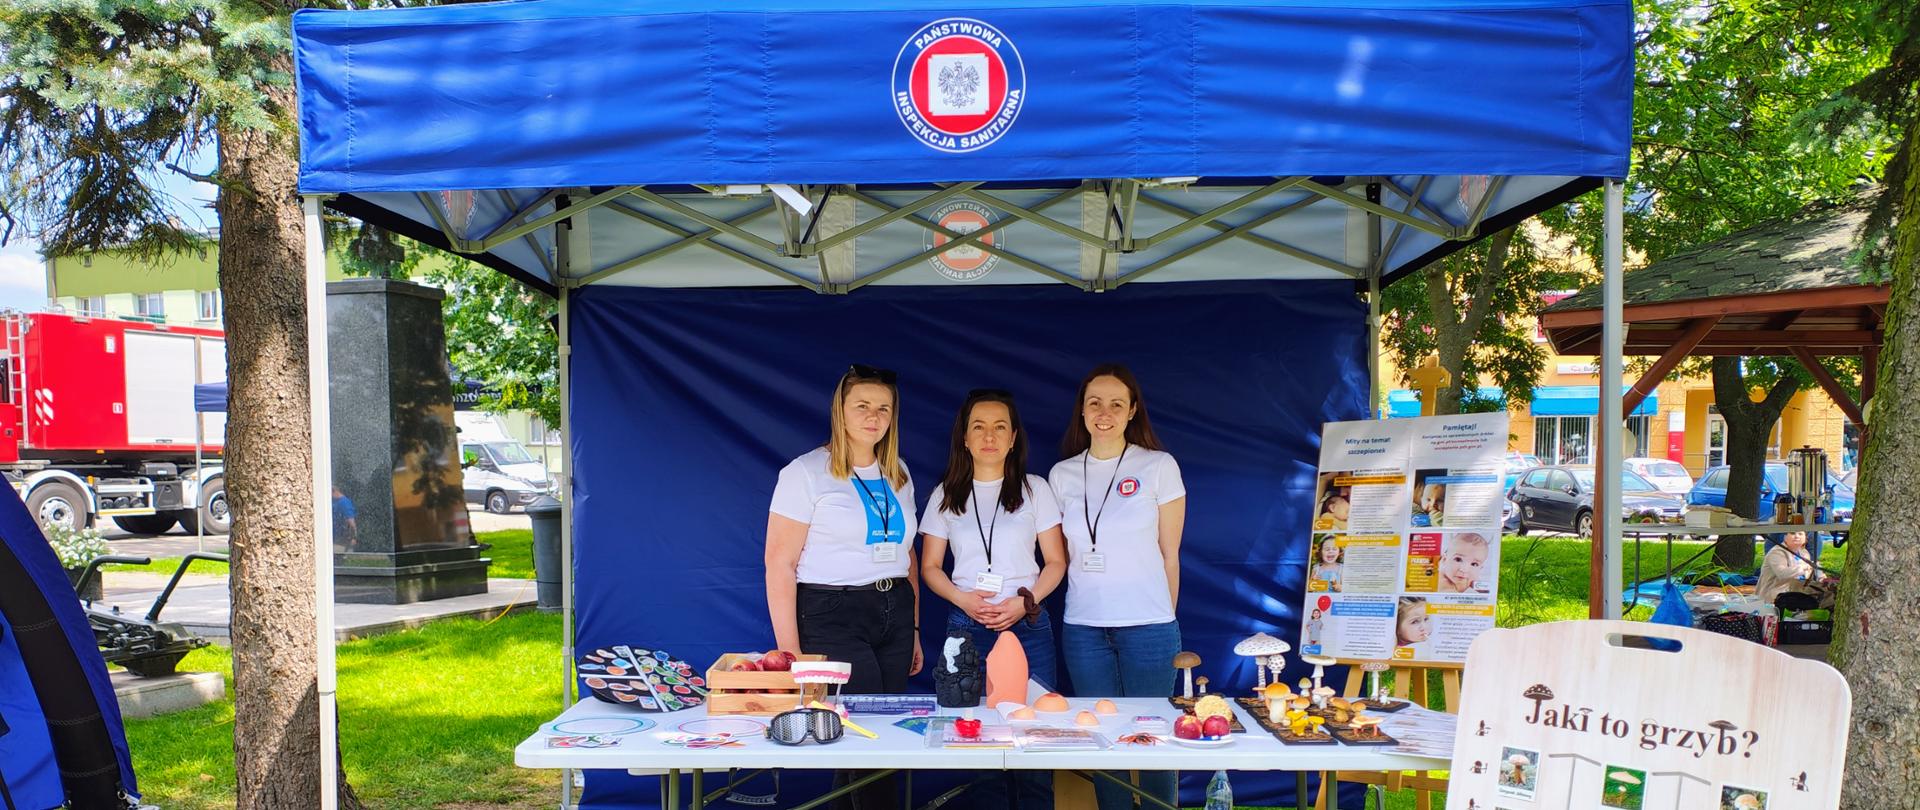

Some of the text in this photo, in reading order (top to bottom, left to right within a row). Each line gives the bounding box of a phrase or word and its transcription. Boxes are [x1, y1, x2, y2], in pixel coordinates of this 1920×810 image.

[914, 22, 1002, 50] PAŃSTWOWA
[897, 89, 1021, 148] INSPEKCJA SANITARNA
[1524, 689, 1760, 759] Jaki to grzyb?
